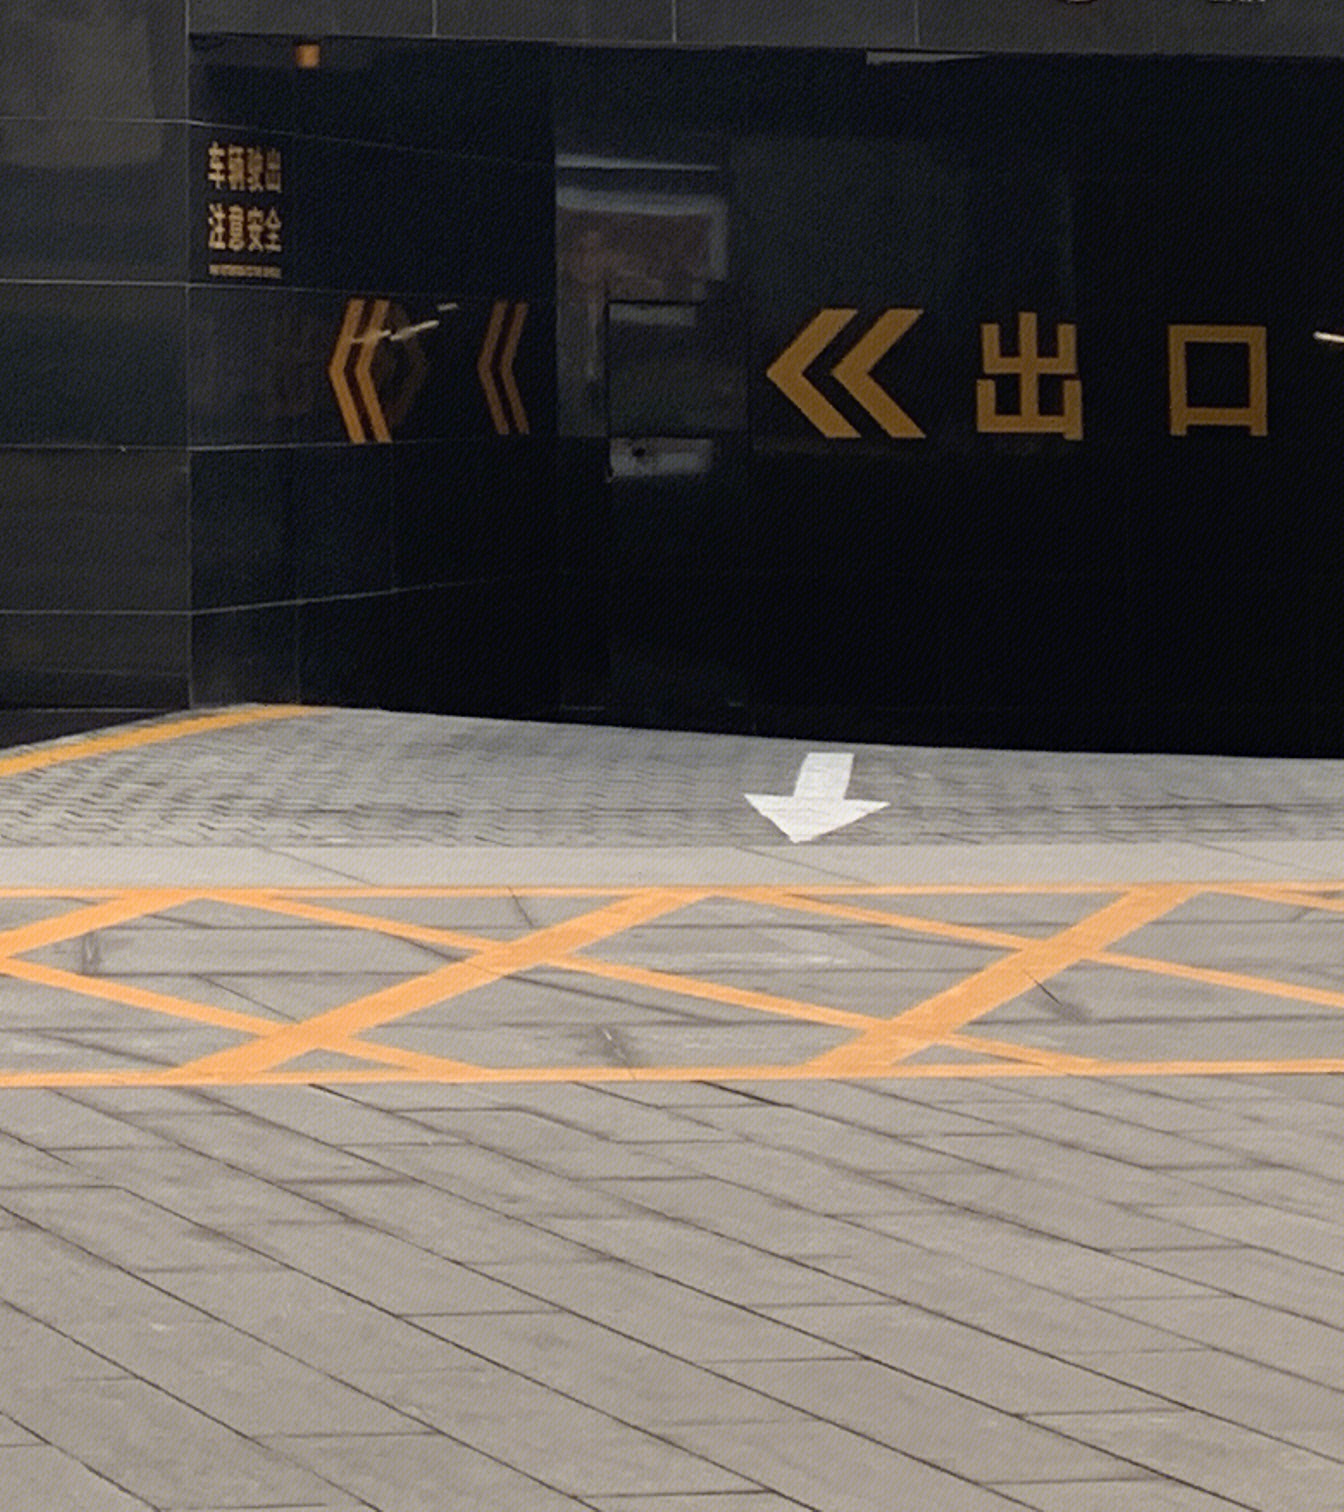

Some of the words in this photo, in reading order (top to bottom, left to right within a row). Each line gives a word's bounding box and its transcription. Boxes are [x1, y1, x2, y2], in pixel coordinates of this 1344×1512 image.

[208, 202, 282, 252] 注意安全
[976, 311, 1268, 441] 出口
